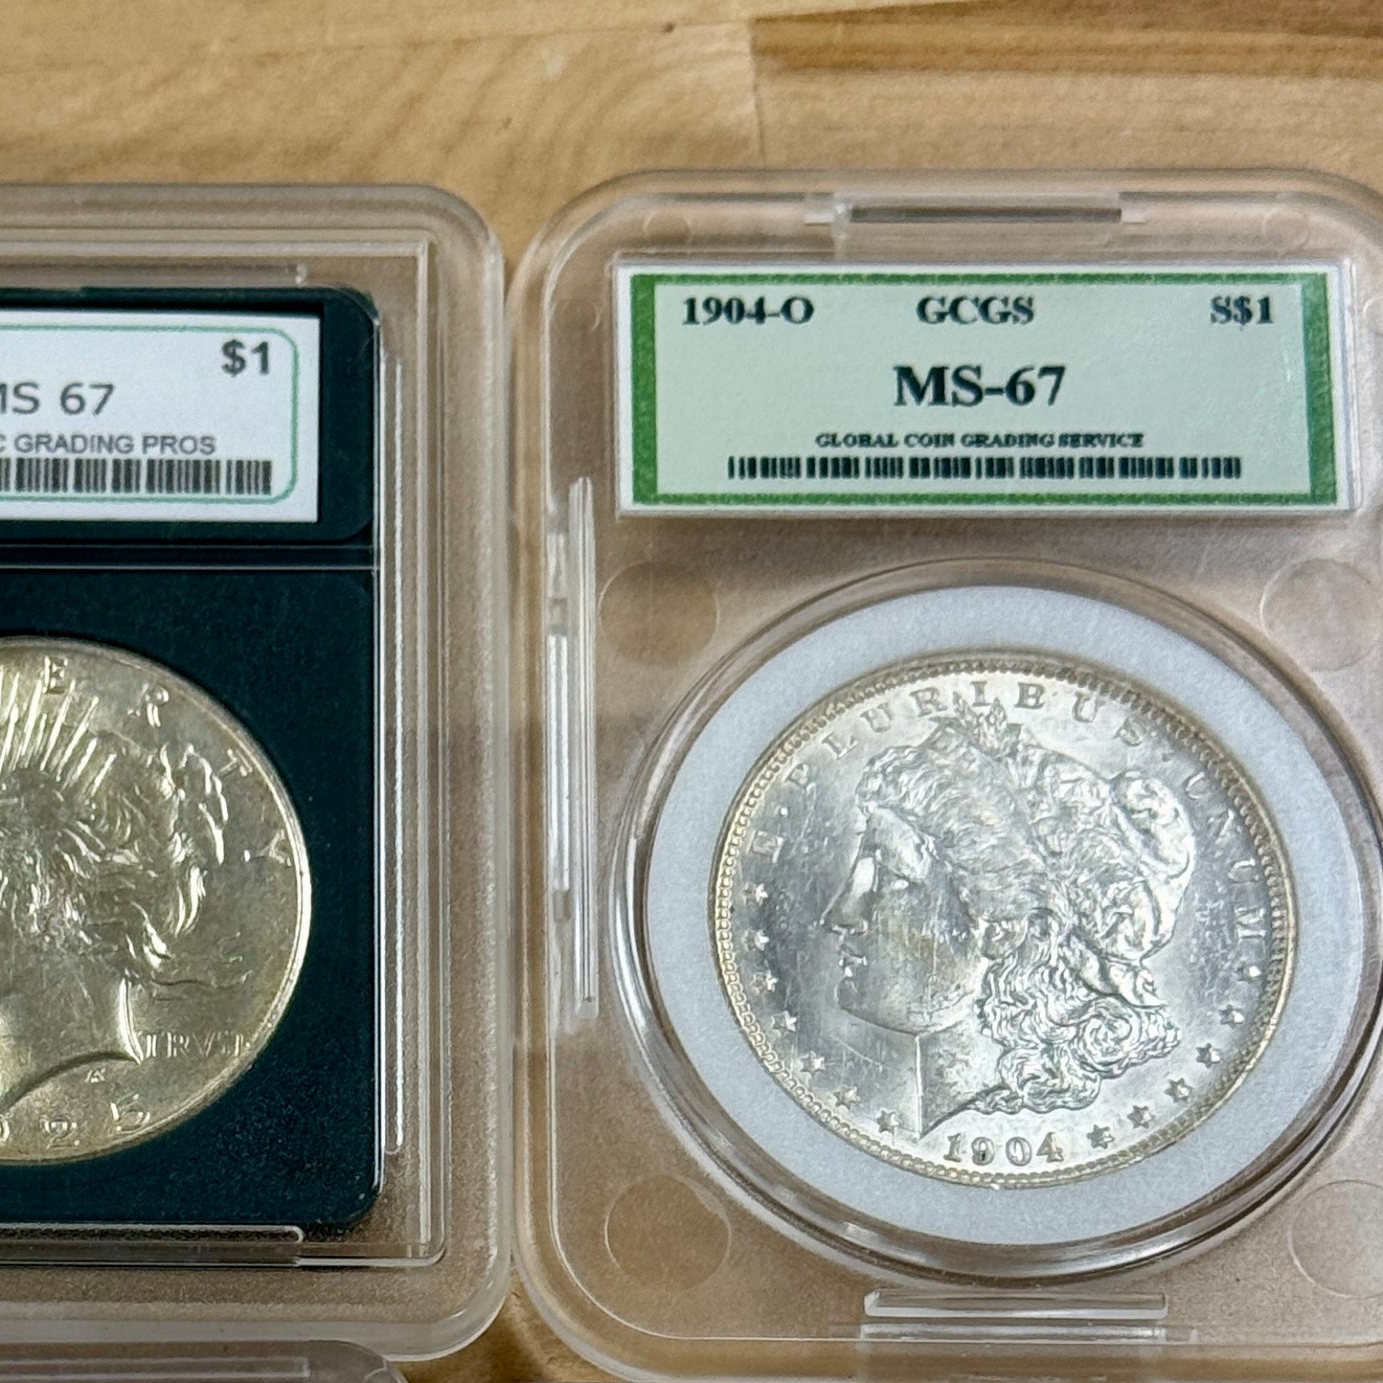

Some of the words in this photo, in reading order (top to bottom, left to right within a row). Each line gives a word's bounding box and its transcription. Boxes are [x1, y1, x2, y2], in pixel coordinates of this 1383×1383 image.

[681, 296, 814, 325] 1904-O
[916, 296, 1035, 325] GCGS
[1210, 293, 1275, 326] S$1
[220, 338, 273, 377] $1
[59, 382, 115, 416] 67
[892, 364, 1067, 408] MS-67
[15, 433, 135, 455] GRADING
[142, 435, 218, 455] PROS
[815, 432, 899, 449] GLOBAL
[903, 432, 955, 449] COIN
[959, 432, 1055, 449] GRADING
[1057, 432, 1145, 449] SERVICE
[943, 1131, 1065, 1167] 1904
